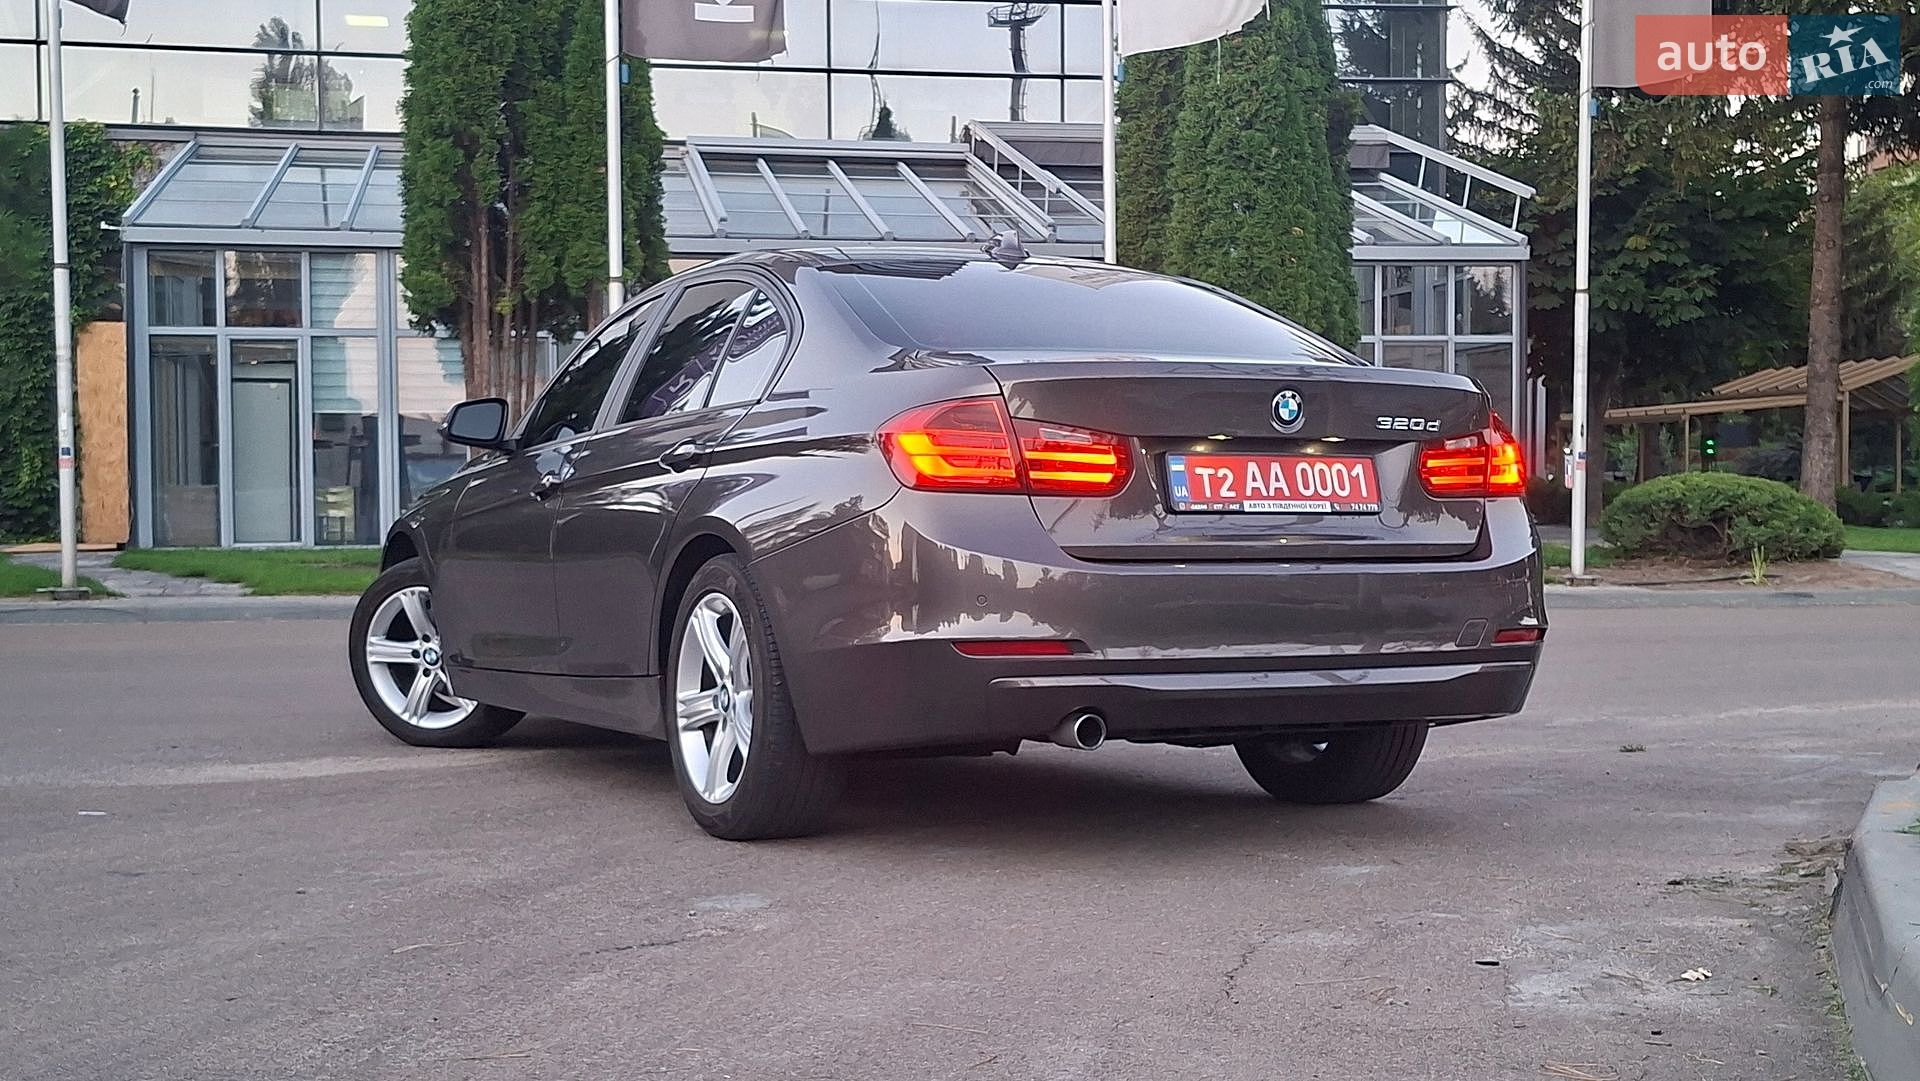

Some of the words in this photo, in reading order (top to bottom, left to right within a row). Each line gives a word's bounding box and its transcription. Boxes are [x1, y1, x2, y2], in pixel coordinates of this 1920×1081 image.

[1376, 416, 1441, 431] 320d
[1194, 467, 1237, 498] T2
[1245, 461, 1291, 497] AA
[1295, 462, 1369, 498] 0001
[1174, 485, 1189, 498] UA
